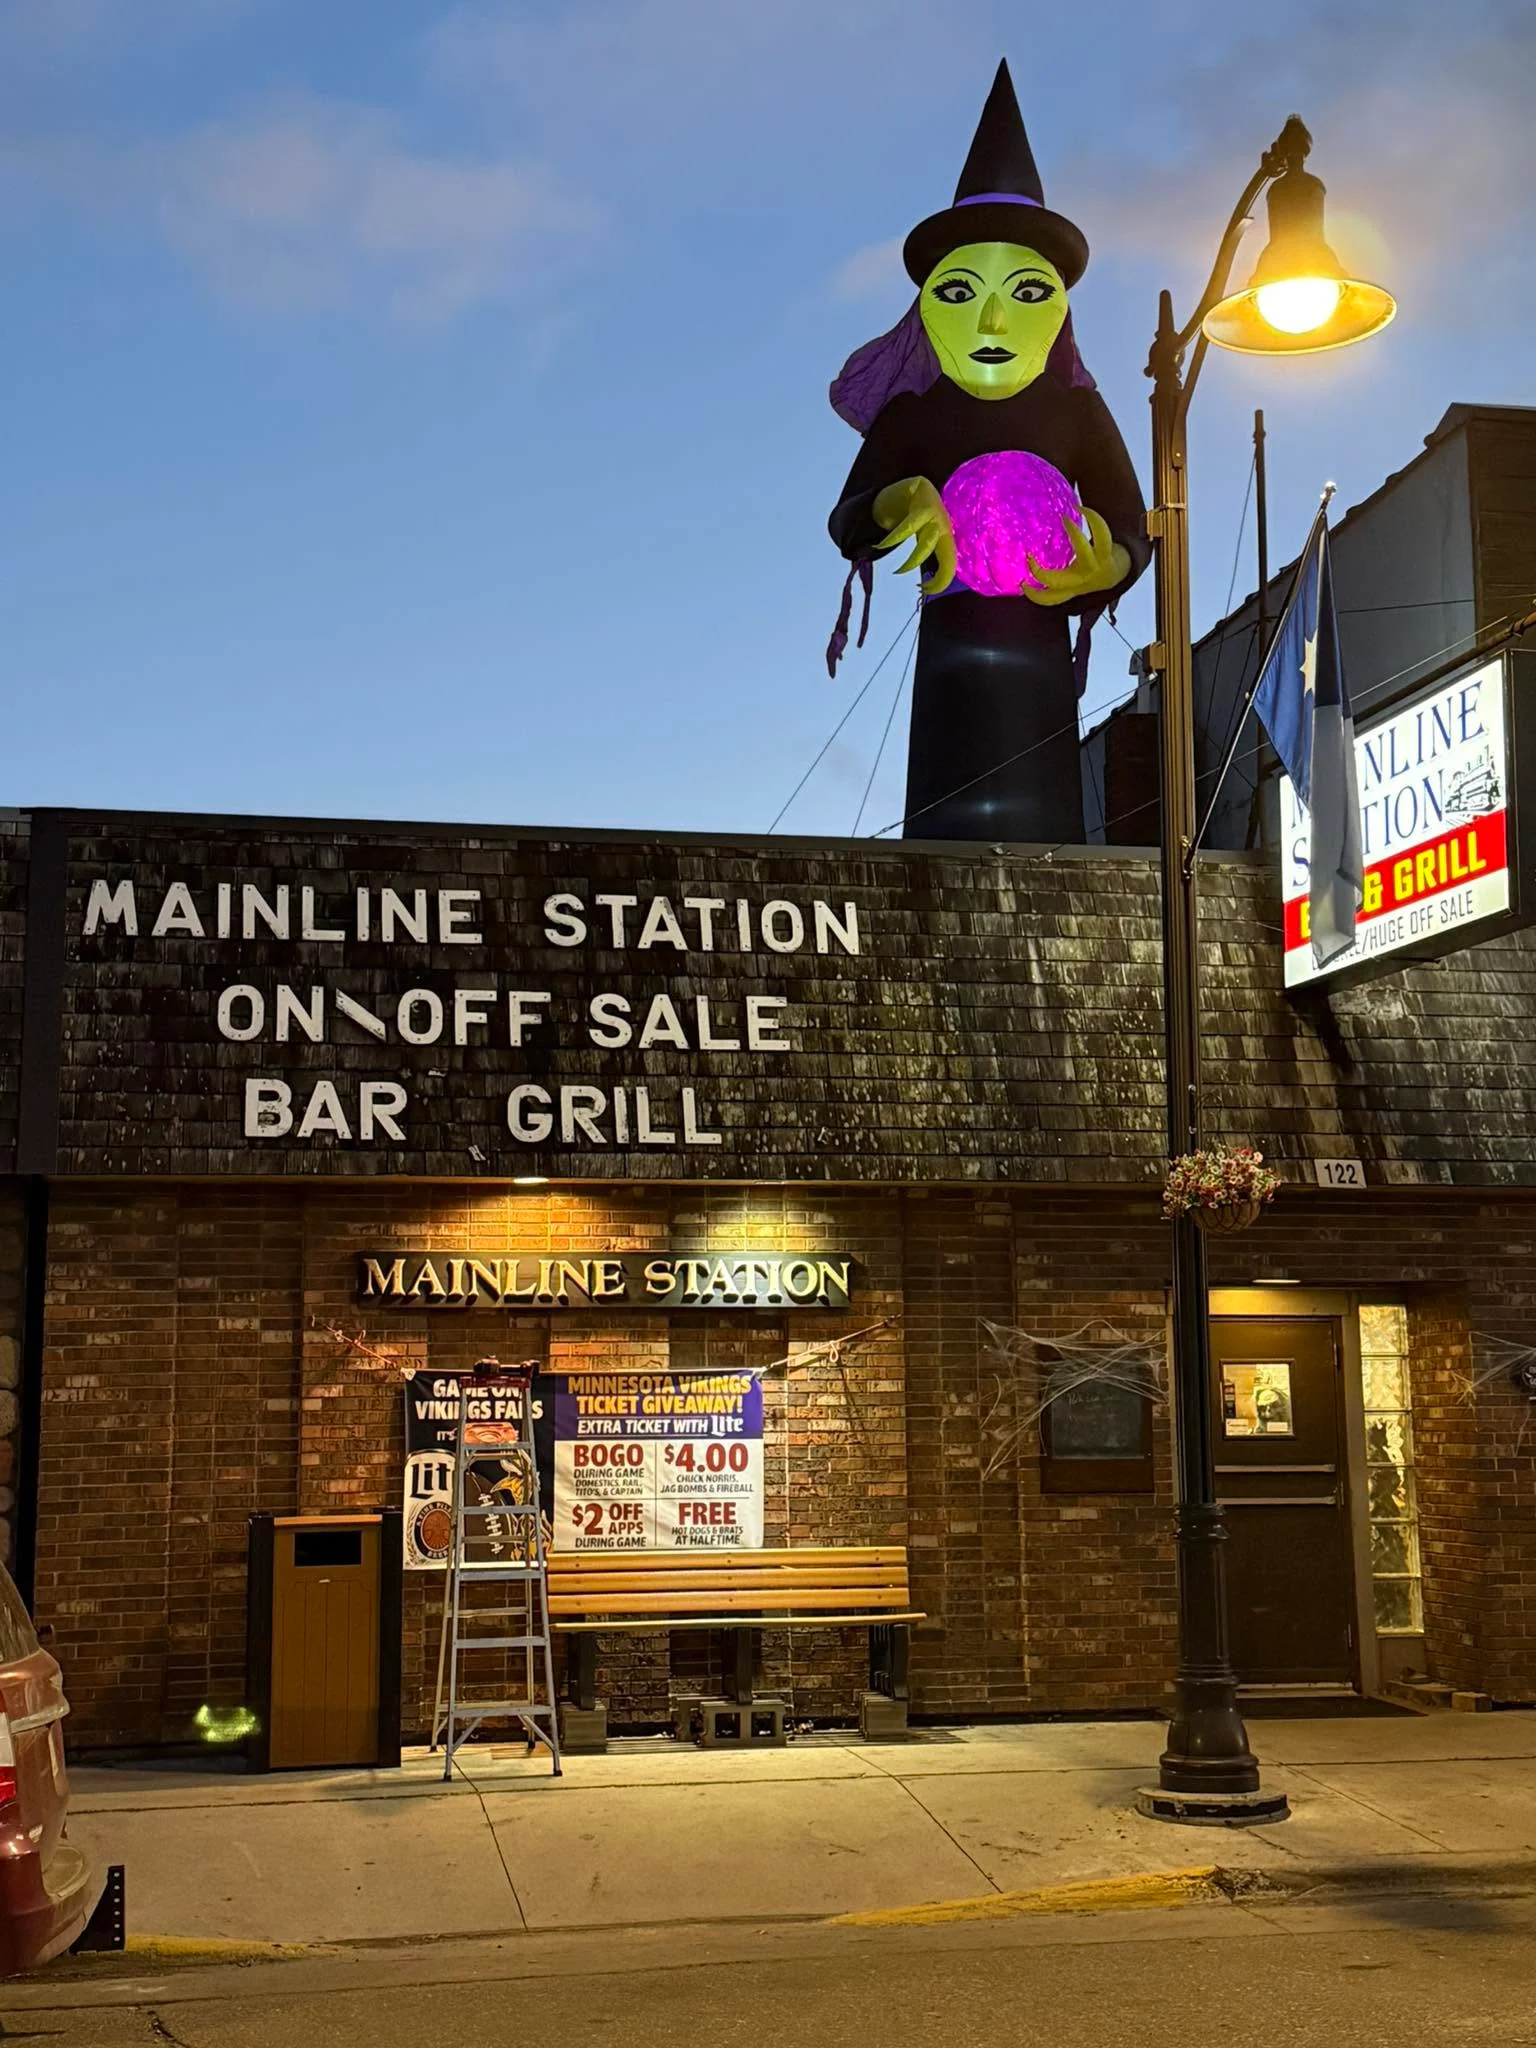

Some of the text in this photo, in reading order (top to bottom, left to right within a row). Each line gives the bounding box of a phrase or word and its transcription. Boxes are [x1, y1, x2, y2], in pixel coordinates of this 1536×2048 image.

[1292, 768, 1445, 888] STION
[1363, 830, 1487, 914] & GRILL
[82, 879, 862, 956] MAINLINE STATION
[1410, 904, 1434, 935] OFF
[1440, 890, 1474, 924] SALE
[588, 992, 793, 1052] SALE
[243, 1076, 723, 1145] BAR GRILL
[1323, 1162, 1359, 1185] 122
[363, 1257, 852, 1298] MAINLINE STATION
[567, 1375, 752, 1394] MINNESOTA VIKINGS
[576, 1394, 743, 1414] TICKET GIVEAWAY!
[577, 1415, 744, 1437] EXTRA TICKET WITH Lite
[574, 1443, 644, 1467] BOGO
[663, 1442, 749, 1473] $4.00
[409, 1462, 451, 1499] Lit
[573, 1467, 645, 1478] DURING GAME
[676, 1474, 704, 1483] CHUCK
[603, 1487, 609, 1496] &
[610, 1487, 643, 1495] CAPTAIN
[660, 1484, 754, 1493] JAG BOMBS & FIREBALL
[572, 1502, 644, 1536] $2 OFF
[678, 1502, 737, 1525] FREE
[608, 1521, 644, 1535] APPS
[672, 1526, 744, 1535] HOT DOGS & BRATS
[575, 1537, 647, 1548] DURING GAME
[675, 1535, 741, 1545] AT HALFTIME
